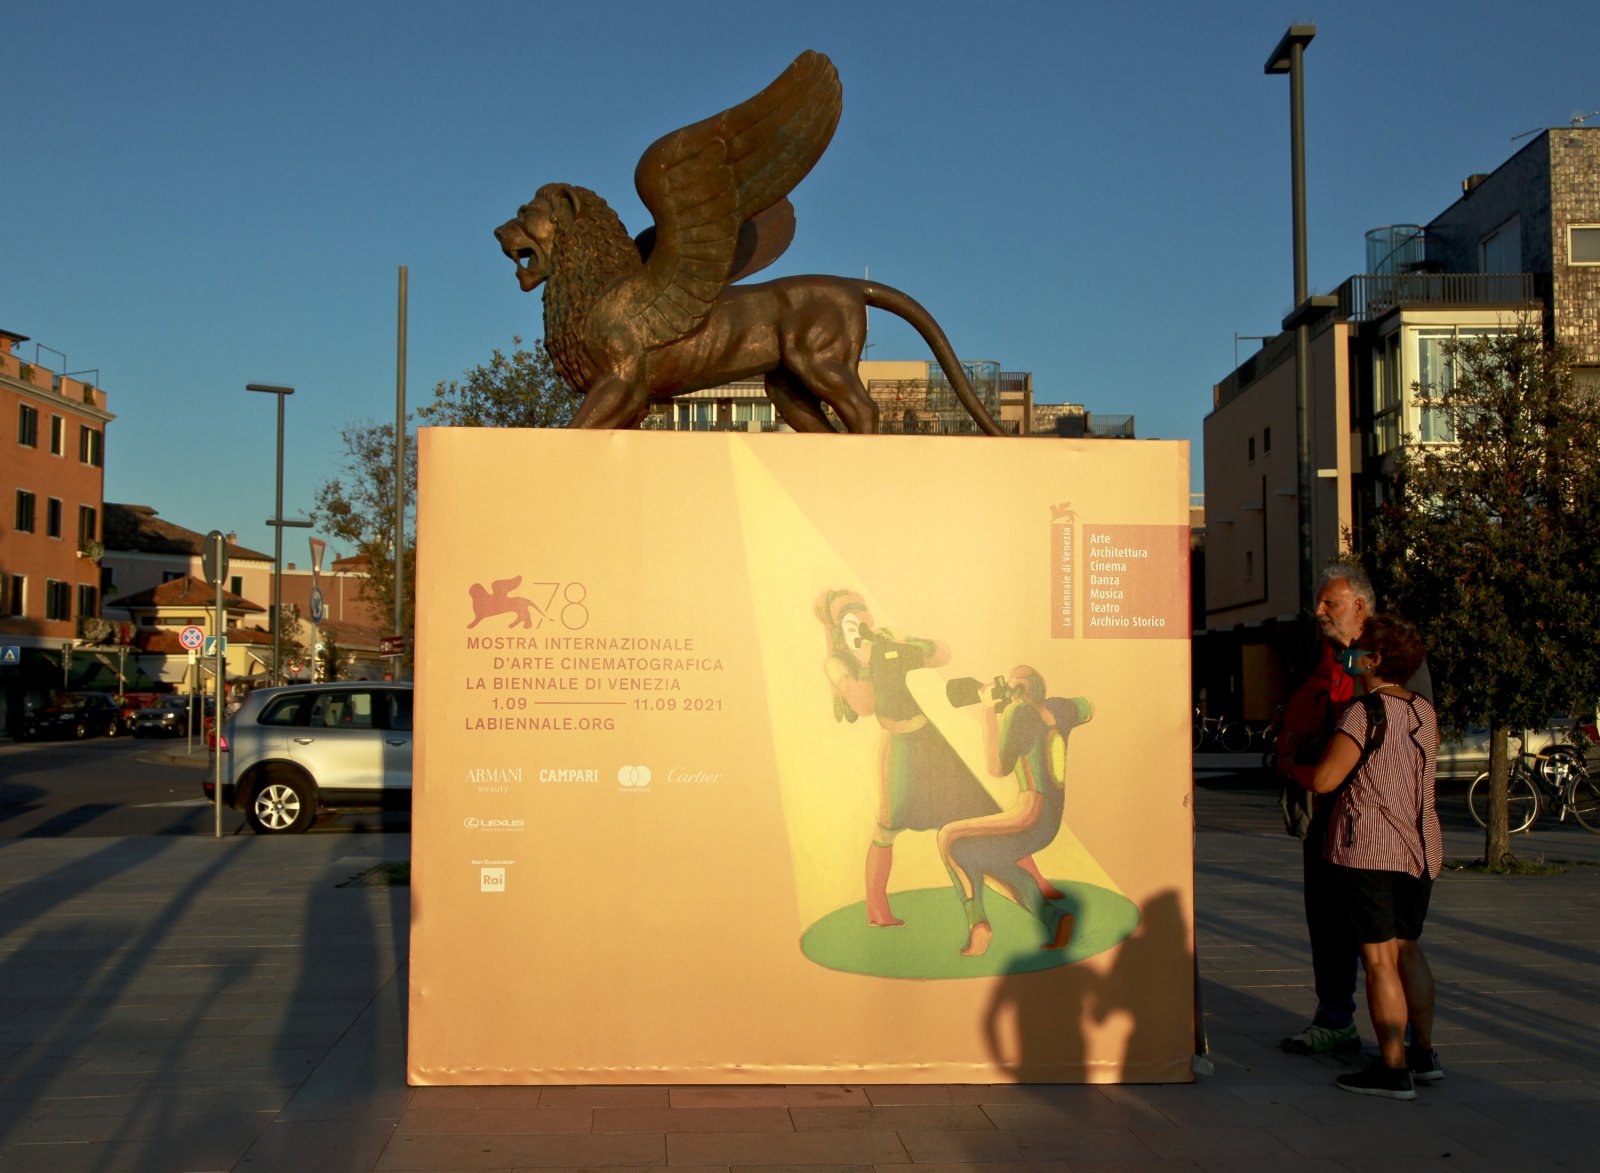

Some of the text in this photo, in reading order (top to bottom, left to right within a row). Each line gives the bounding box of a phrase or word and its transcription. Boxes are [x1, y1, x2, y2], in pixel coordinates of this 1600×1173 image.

[1090, 534, 1110, 544] Arte
[1090, 547, 1148, 558] Architettura
[1090, 560, 1126, 572] Cinema
[1062, 527, 1071, 626] La Biennale di Venezia
[1090, 575, 1120, 585] Danza
[1090, 588, 1124, 598] Musica
[532, 582, 589, 630] 78
[1090, 602, 1120, 612] Teatro
[1090, 616, 1165, 627] Archivio Storico
[467, 637, 694, 650] MOSTRA INTERNAZIONALE
[494, 658, 724, 671] D'ARTE CINEMATOGRAFICA
[466, 678, 680, 690] LA BIENNALE DI VENEZIA
[492, 698, 722, 711] 1.09 11.09 2021
[466, 718, 615, 730] LABIENNALE.ORG
[466, 768, 522, 782] ARMANI
[539, 768, 598, 782] CAMPARI
[668, 766, 722, 784] Cartier
[483, 874, 502, 885] Rai
